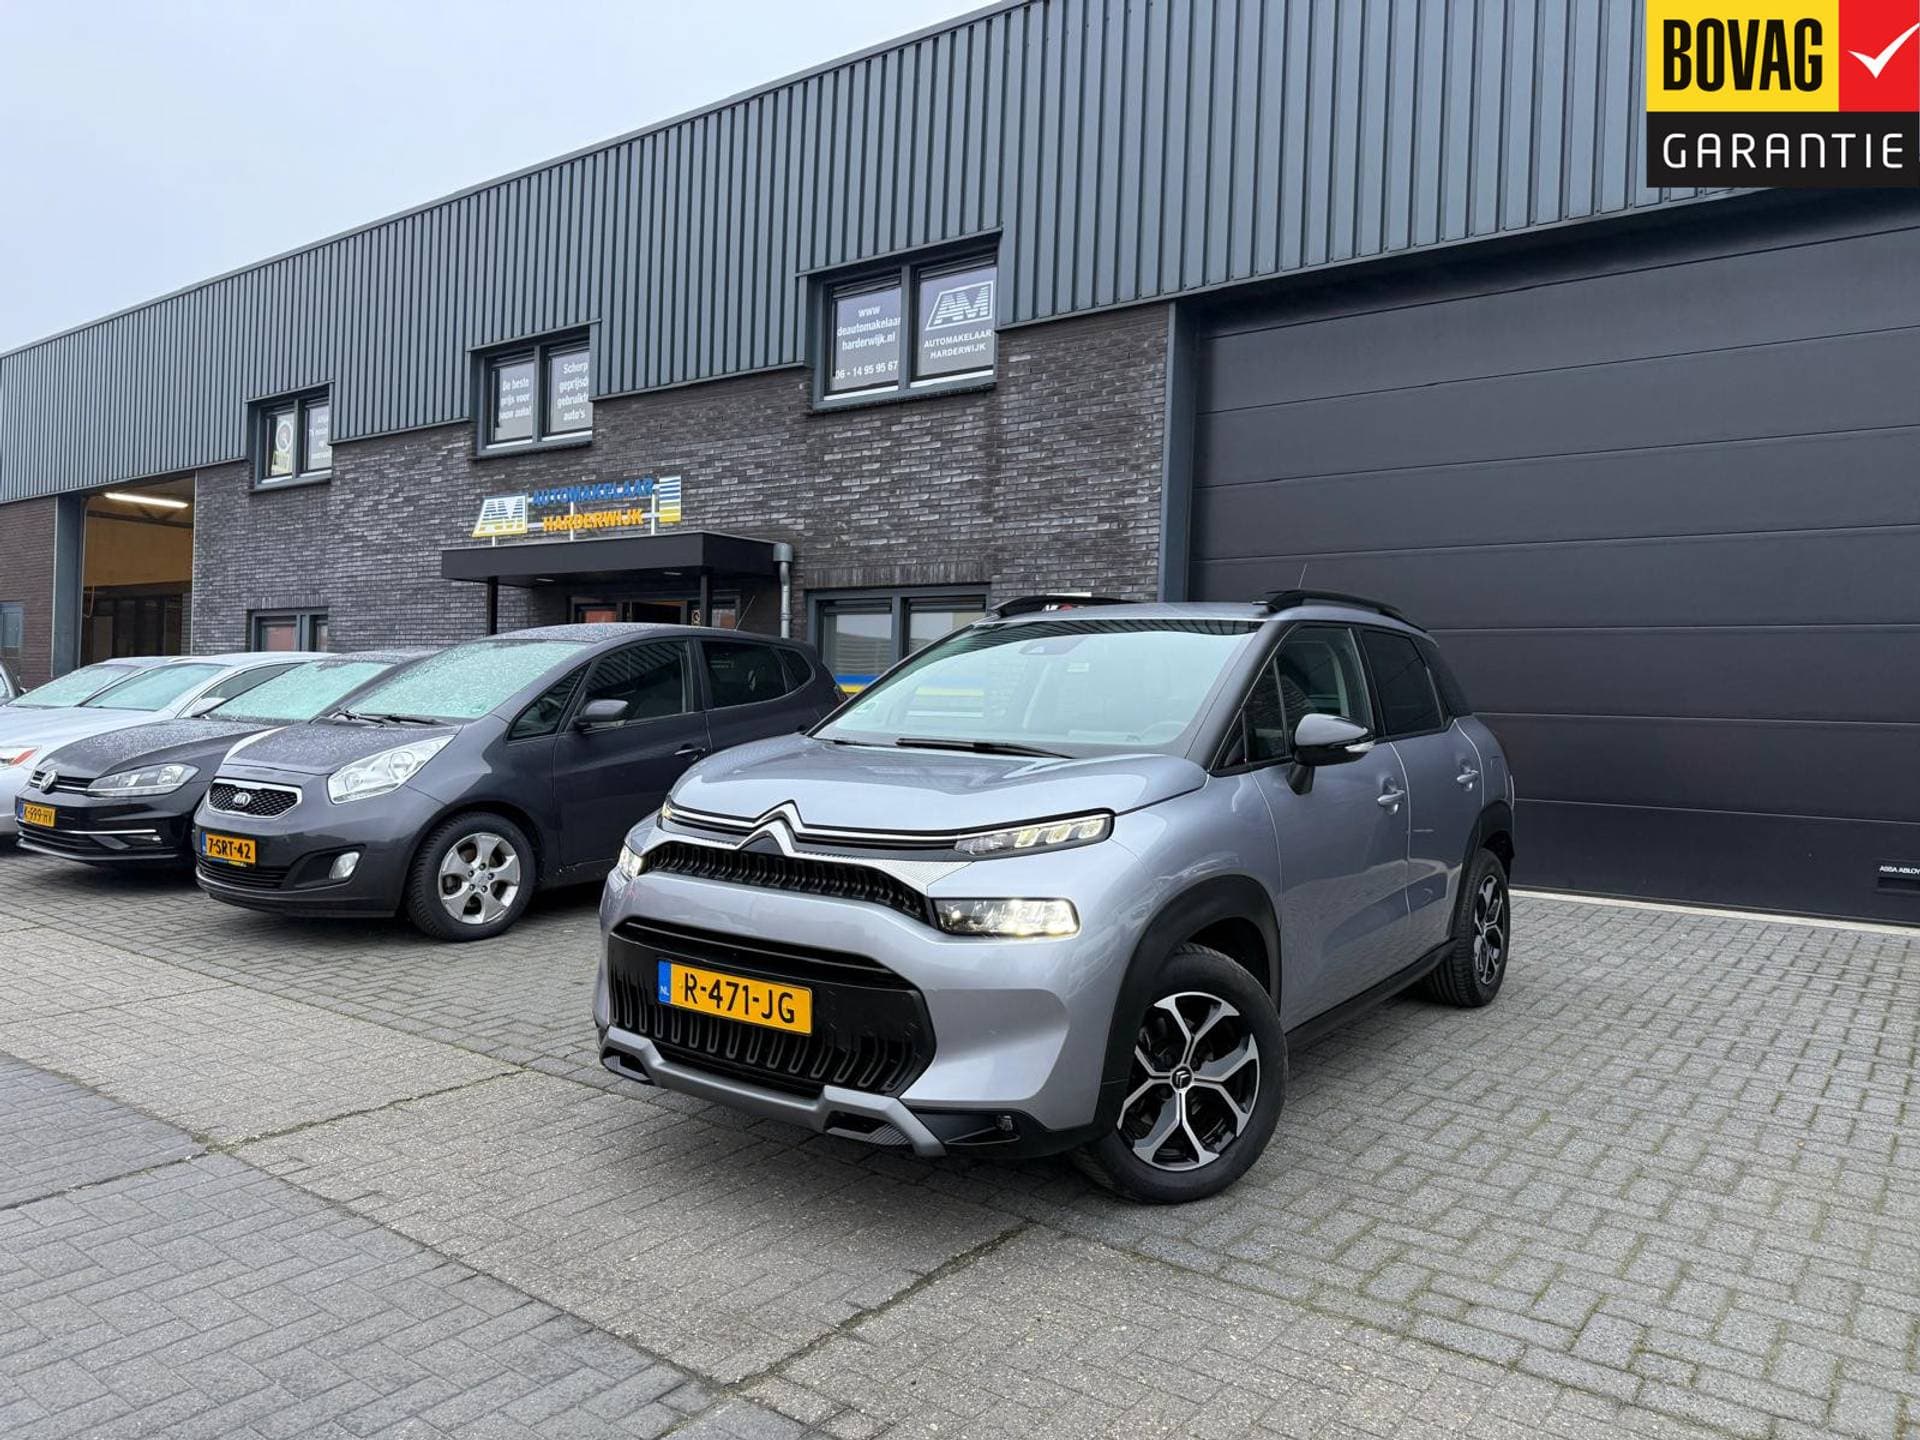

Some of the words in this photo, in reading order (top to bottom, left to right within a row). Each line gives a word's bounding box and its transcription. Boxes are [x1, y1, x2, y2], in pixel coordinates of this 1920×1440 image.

[837, 317, 901, 337] deautomakelaar
[842, 331, 896, 351] harderwijk.nl
[924, 329, 992, 348] AUTOMAKELAAR
[930, 342, 986, 360] HARDERWIJK
[853, 366, 862, 377] 14
[864, 364, 874, 375] 95
[876, 362, 886, 373] 95
[532, 478, 654, 505] AUTOMAKELAAR
[543, 508, 644, 533] HARDERWIJK
[208, 838, 251, 859] 7-SRT-42
[684, 973, 795, 1024] R-471-JG
